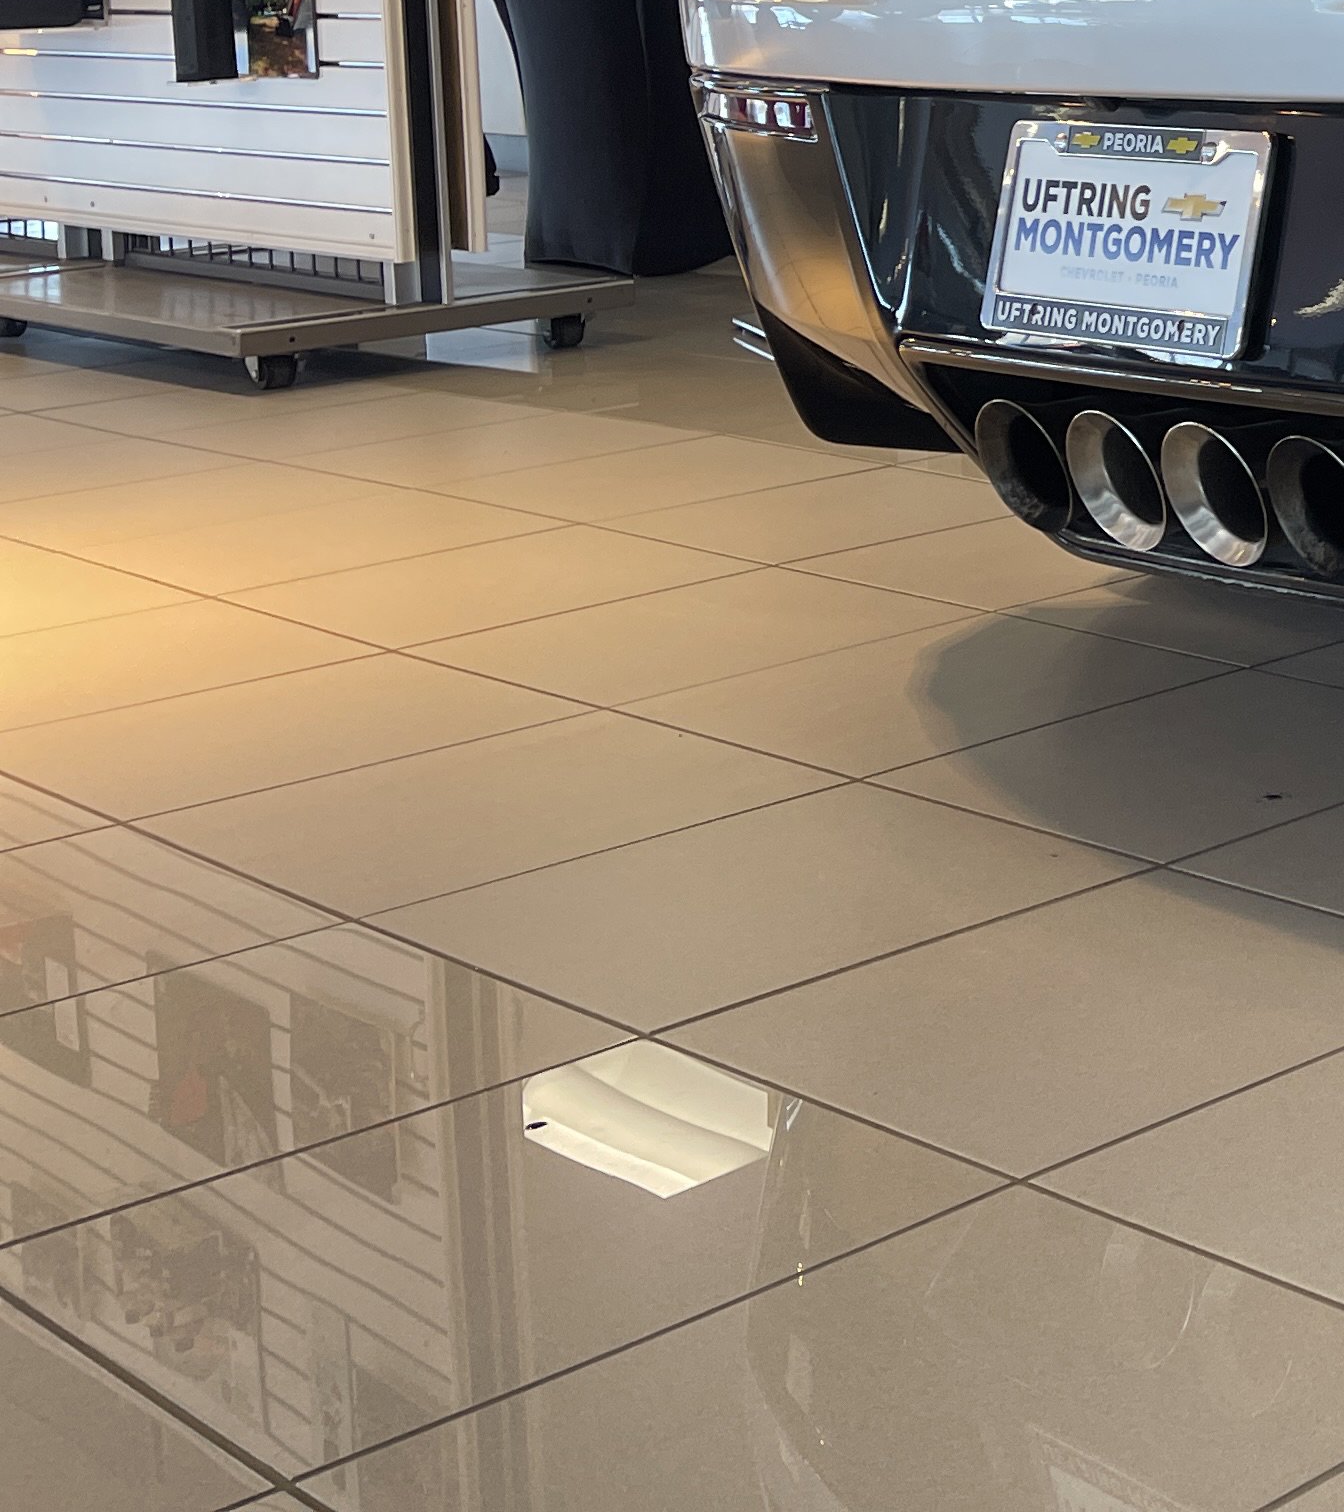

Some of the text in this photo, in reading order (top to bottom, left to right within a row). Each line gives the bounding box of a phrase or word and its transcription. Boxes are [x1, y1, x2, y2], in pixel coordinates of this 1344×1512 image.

[1102, 132, 1163, 154] PEORIA
[1022, 177, 1151, 221] UFTRING
[1014, 217, 1240, 270] MONTGOMERY
[1060, 265, 1179, 288] CHEVROLET PEORIA
[997, 300, 1221, 346] UFTRING MONTGOMERY
